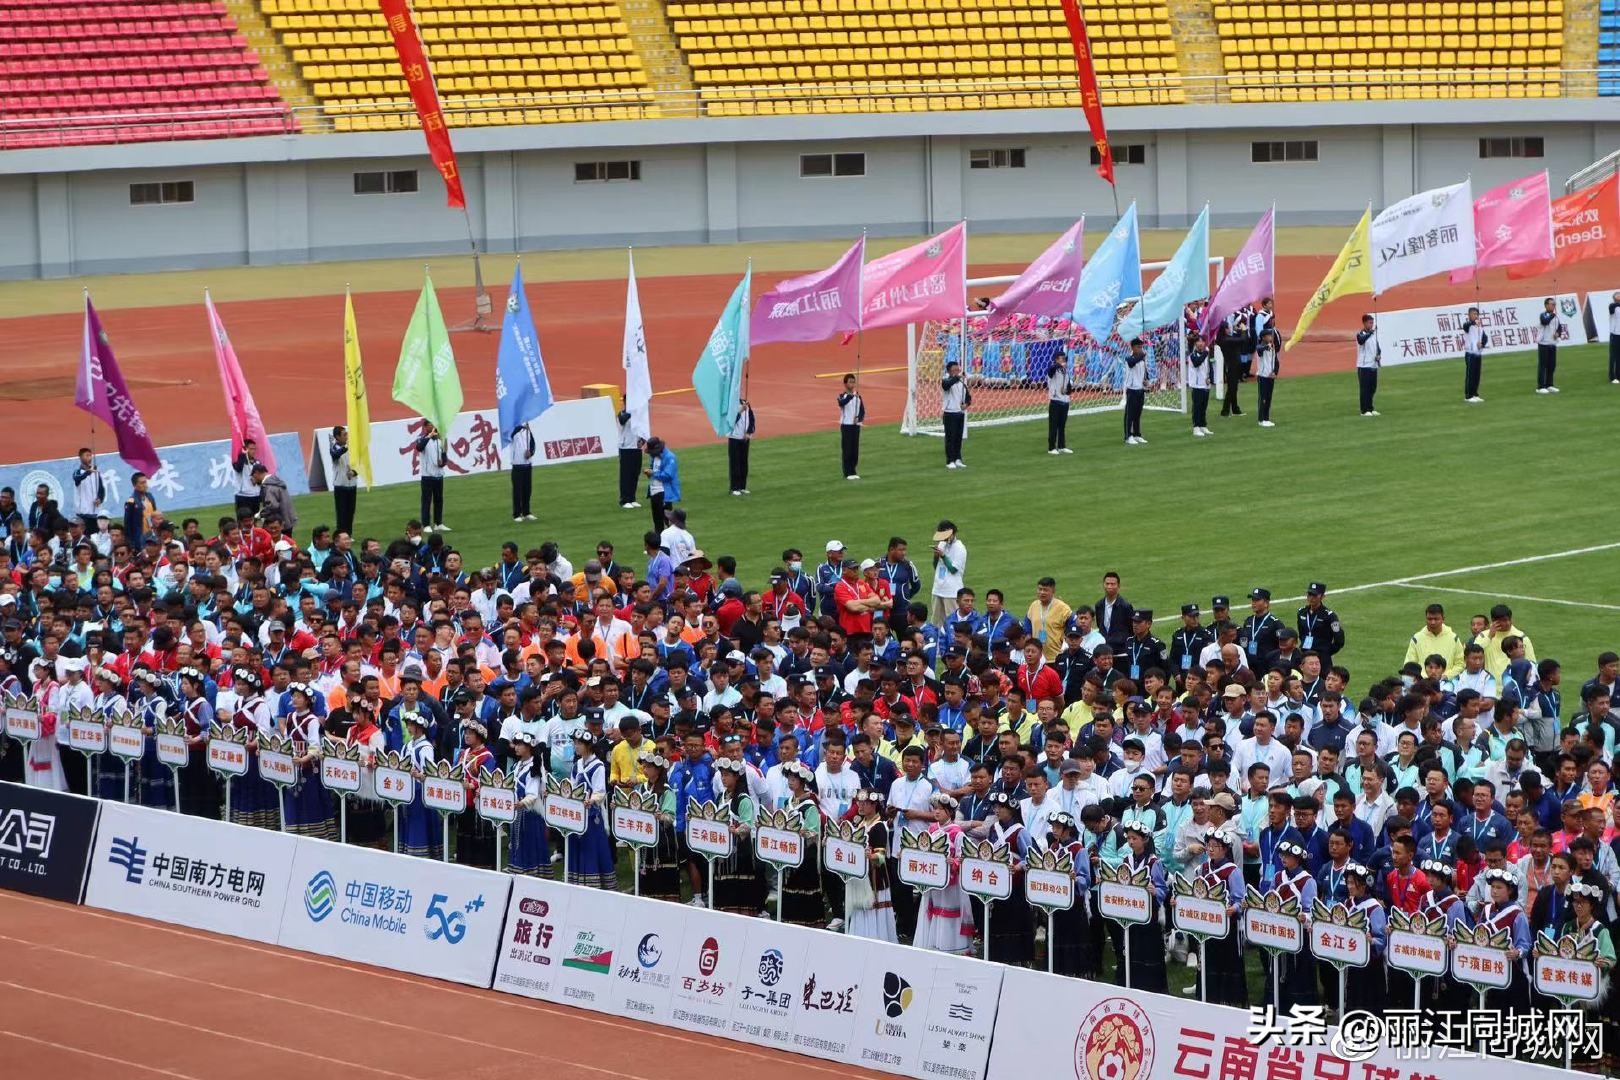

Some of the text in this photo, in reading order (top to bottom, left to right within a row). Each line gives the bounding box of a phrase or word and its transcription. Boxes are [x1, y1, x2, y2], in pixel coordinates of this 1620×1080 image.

[1436, 307, 1520, 332] 丽江古城区
[325, 765, 358, 782] 天和公司
[383, 777, 405, 791] 金沙
[426, 786, 461, 802] 滴滴出行
[481, 795, 513, 811] 古城公安
[616, 817, 654, 835] 三羊开泰
[691, 827, 727, 845] 三朵园林
[834, 847, 857, 865] 金山
[152, 852, 266, 897] 中国南方电网
[908, 859, 939, 876] 丽水汇
[149, 878, 261, 908] CHINA SOUTHERN POWER GRID
[345, 879, 413, 914] 中国移动
[341, 907, 407, 935] China Mobile
[1250, 919, 1296, 940] 丽江市国投
[513, 918, 554, 949] 旅行
[1320, 932, 1358, 952] 金江乡
[1457, 954, 1505, 975] 宁蒗国投
[681, 975, 727, 997] 百岁坊
[1541, 966, 1593, 987] 壹家传媒
